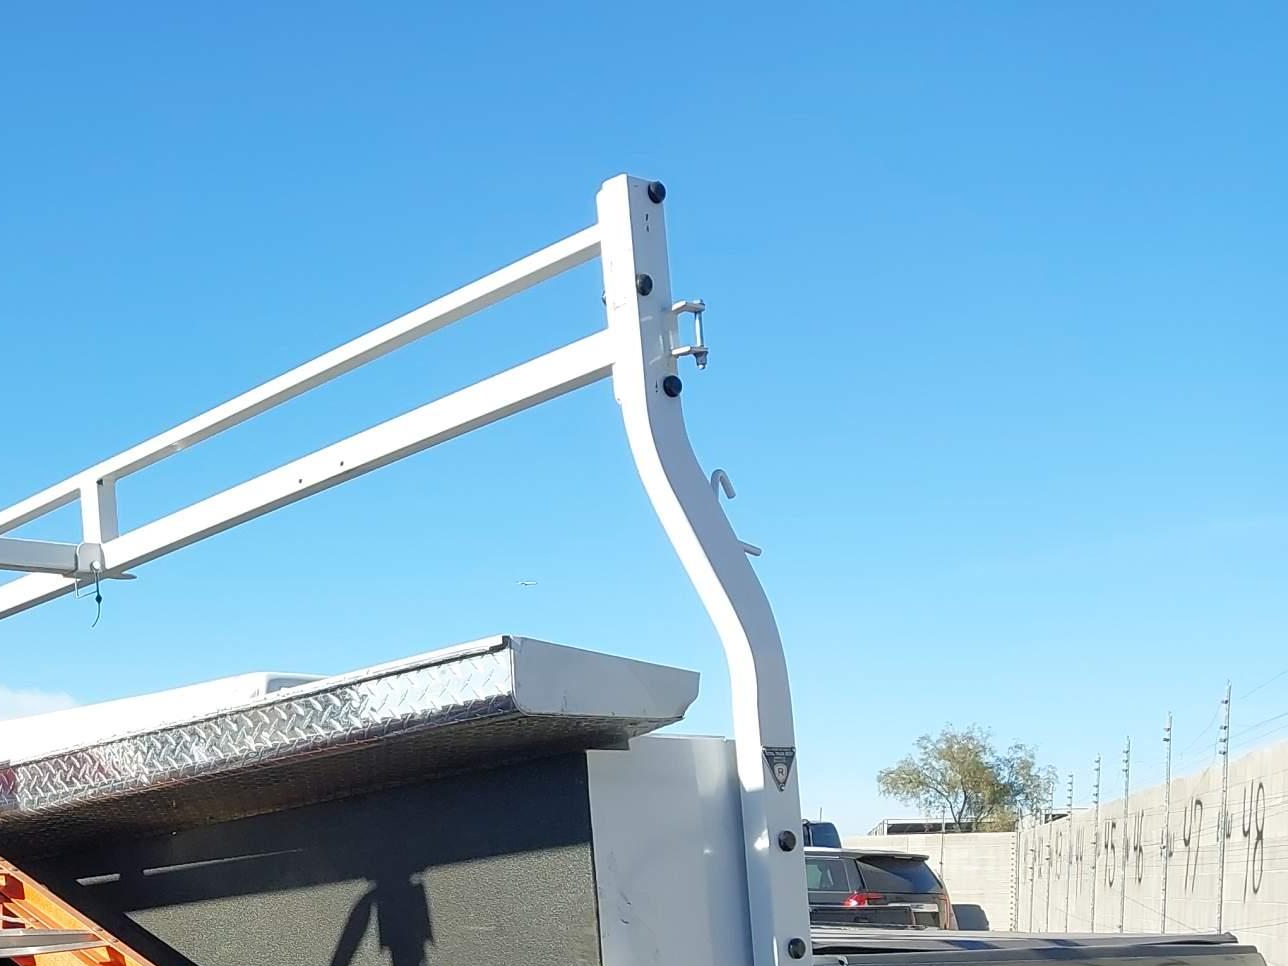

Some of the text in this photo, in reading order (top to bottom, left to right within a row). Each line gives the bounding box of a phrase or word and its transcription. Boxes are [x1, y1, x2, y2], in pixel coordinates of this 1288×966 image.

[1104, 820, 1116, 888] 45
[1133, 808, 1144, 884] 46
[1183, 796, 1203, 895] 47
[1243, 779, 1265, 904] 48
